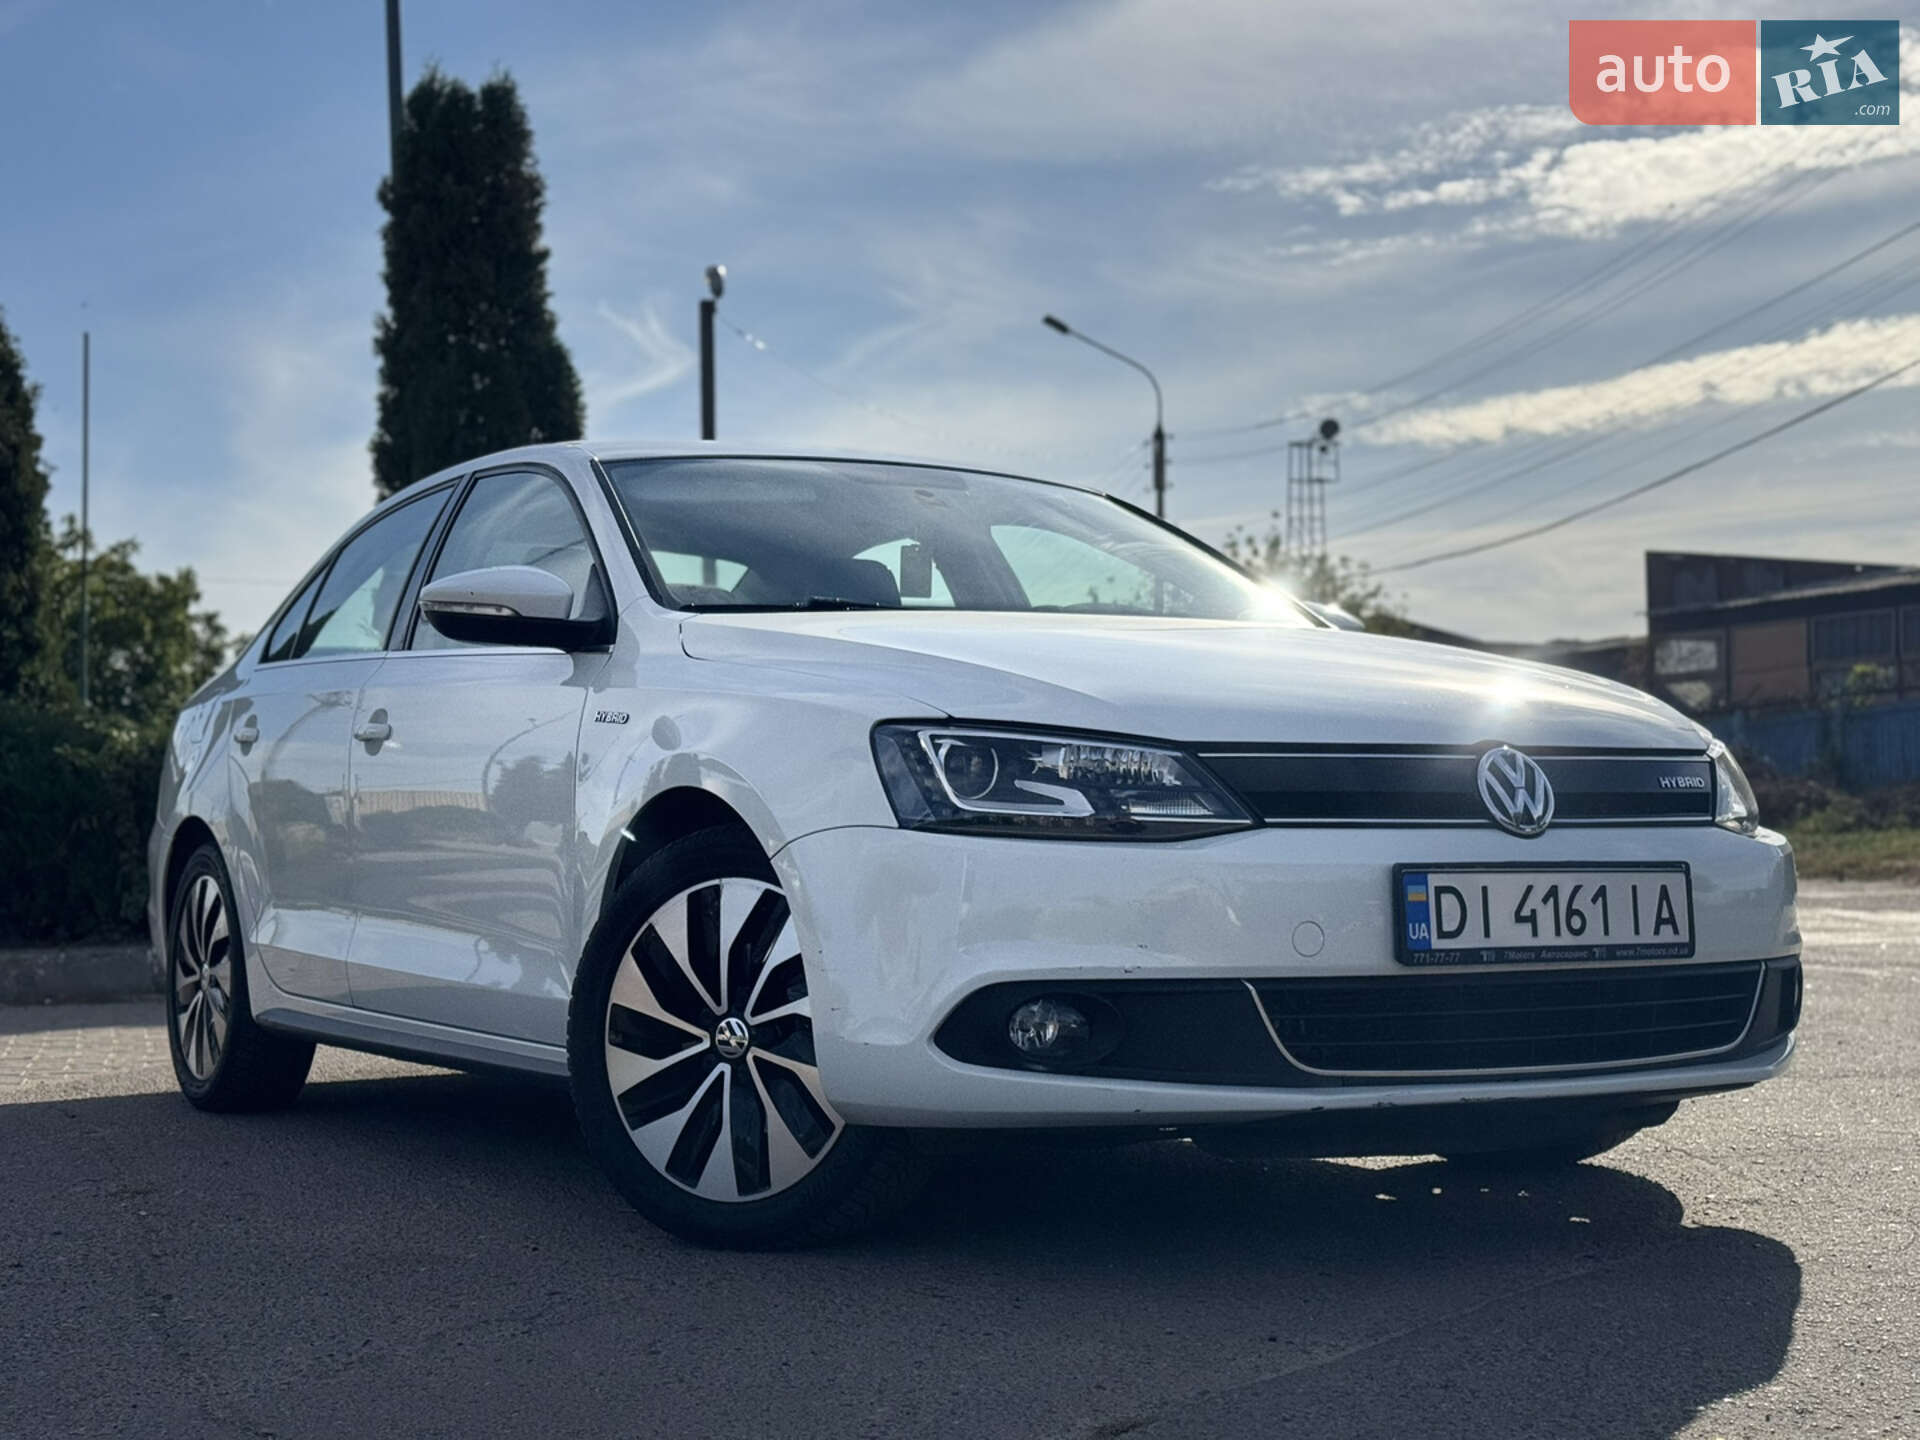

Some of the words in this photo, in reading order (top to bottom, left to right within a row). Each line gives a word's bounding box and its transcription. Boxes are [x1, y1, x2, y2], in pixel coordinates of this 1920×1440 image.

[594, 711, 630, 724] HYBRID
[1658, 776, 1705, 788] HYBRID
[1433, 885, 1491, 940] DI
[1514, 884, 1610, 938] 4161
[1631, 884, 1680, 936] IA
[1408, 922, 1430, 940] UA
[1413, 952, 1461, 963] 771-77-77
